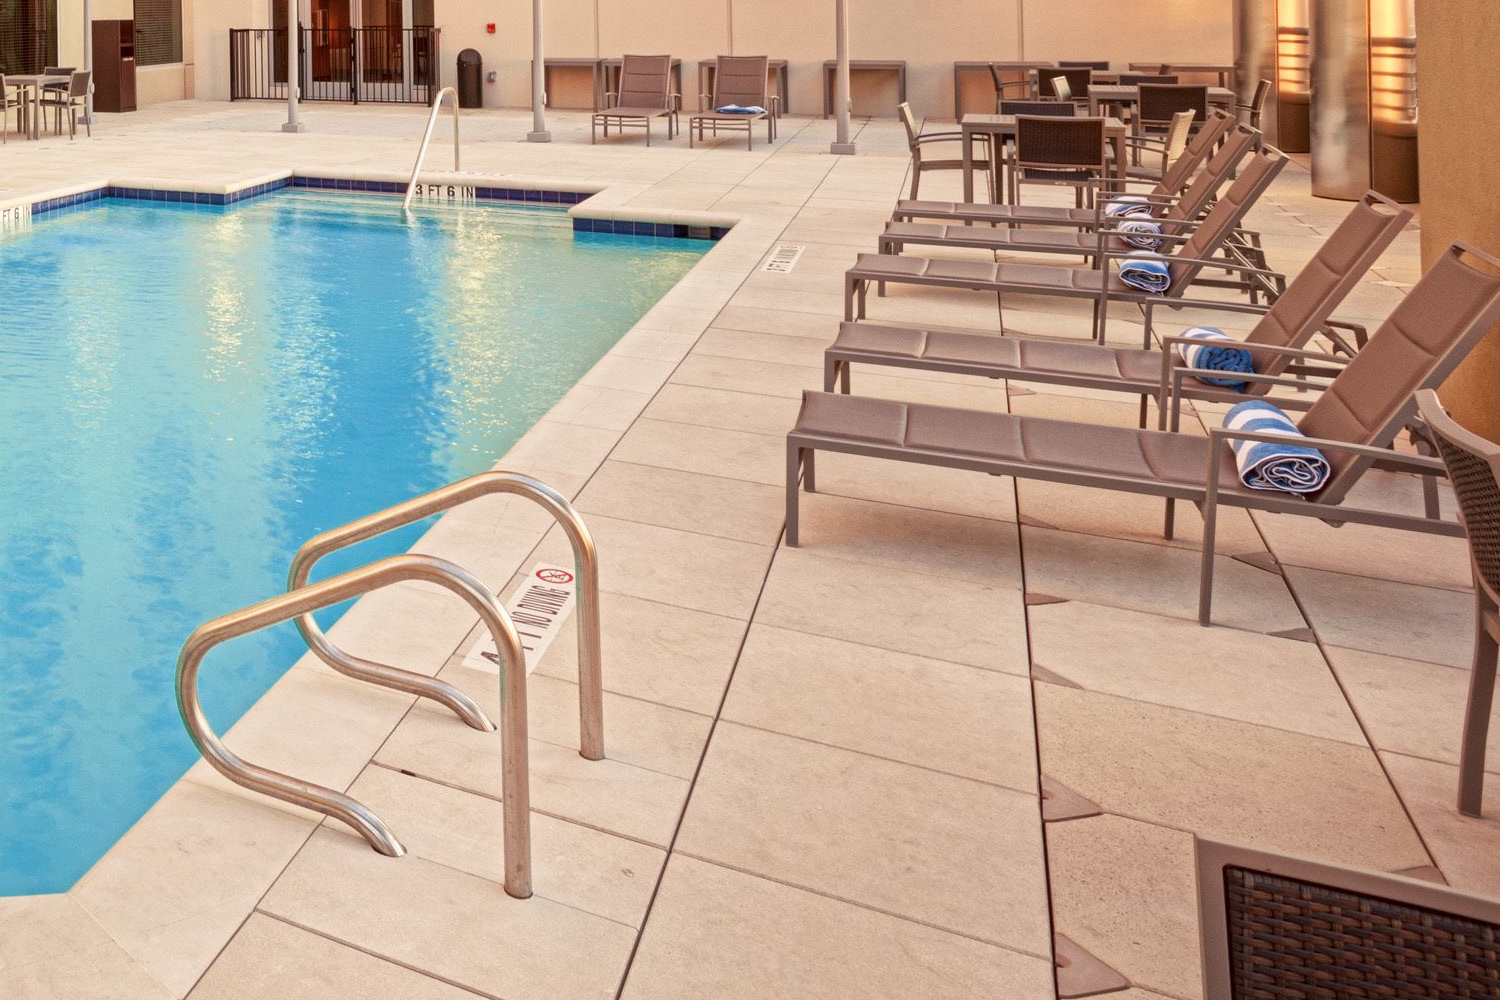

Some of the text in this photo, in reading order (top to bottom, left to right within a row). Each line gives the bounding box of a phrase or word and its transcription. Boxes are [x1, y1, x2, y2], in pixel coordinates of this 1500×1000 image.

[416, 184, 473, 197] 3 FT 6 IN
[15, 208, 19, 219] 6
[516, 585, 571, 616] DIVING
[510, 611, 552, 629] NO
